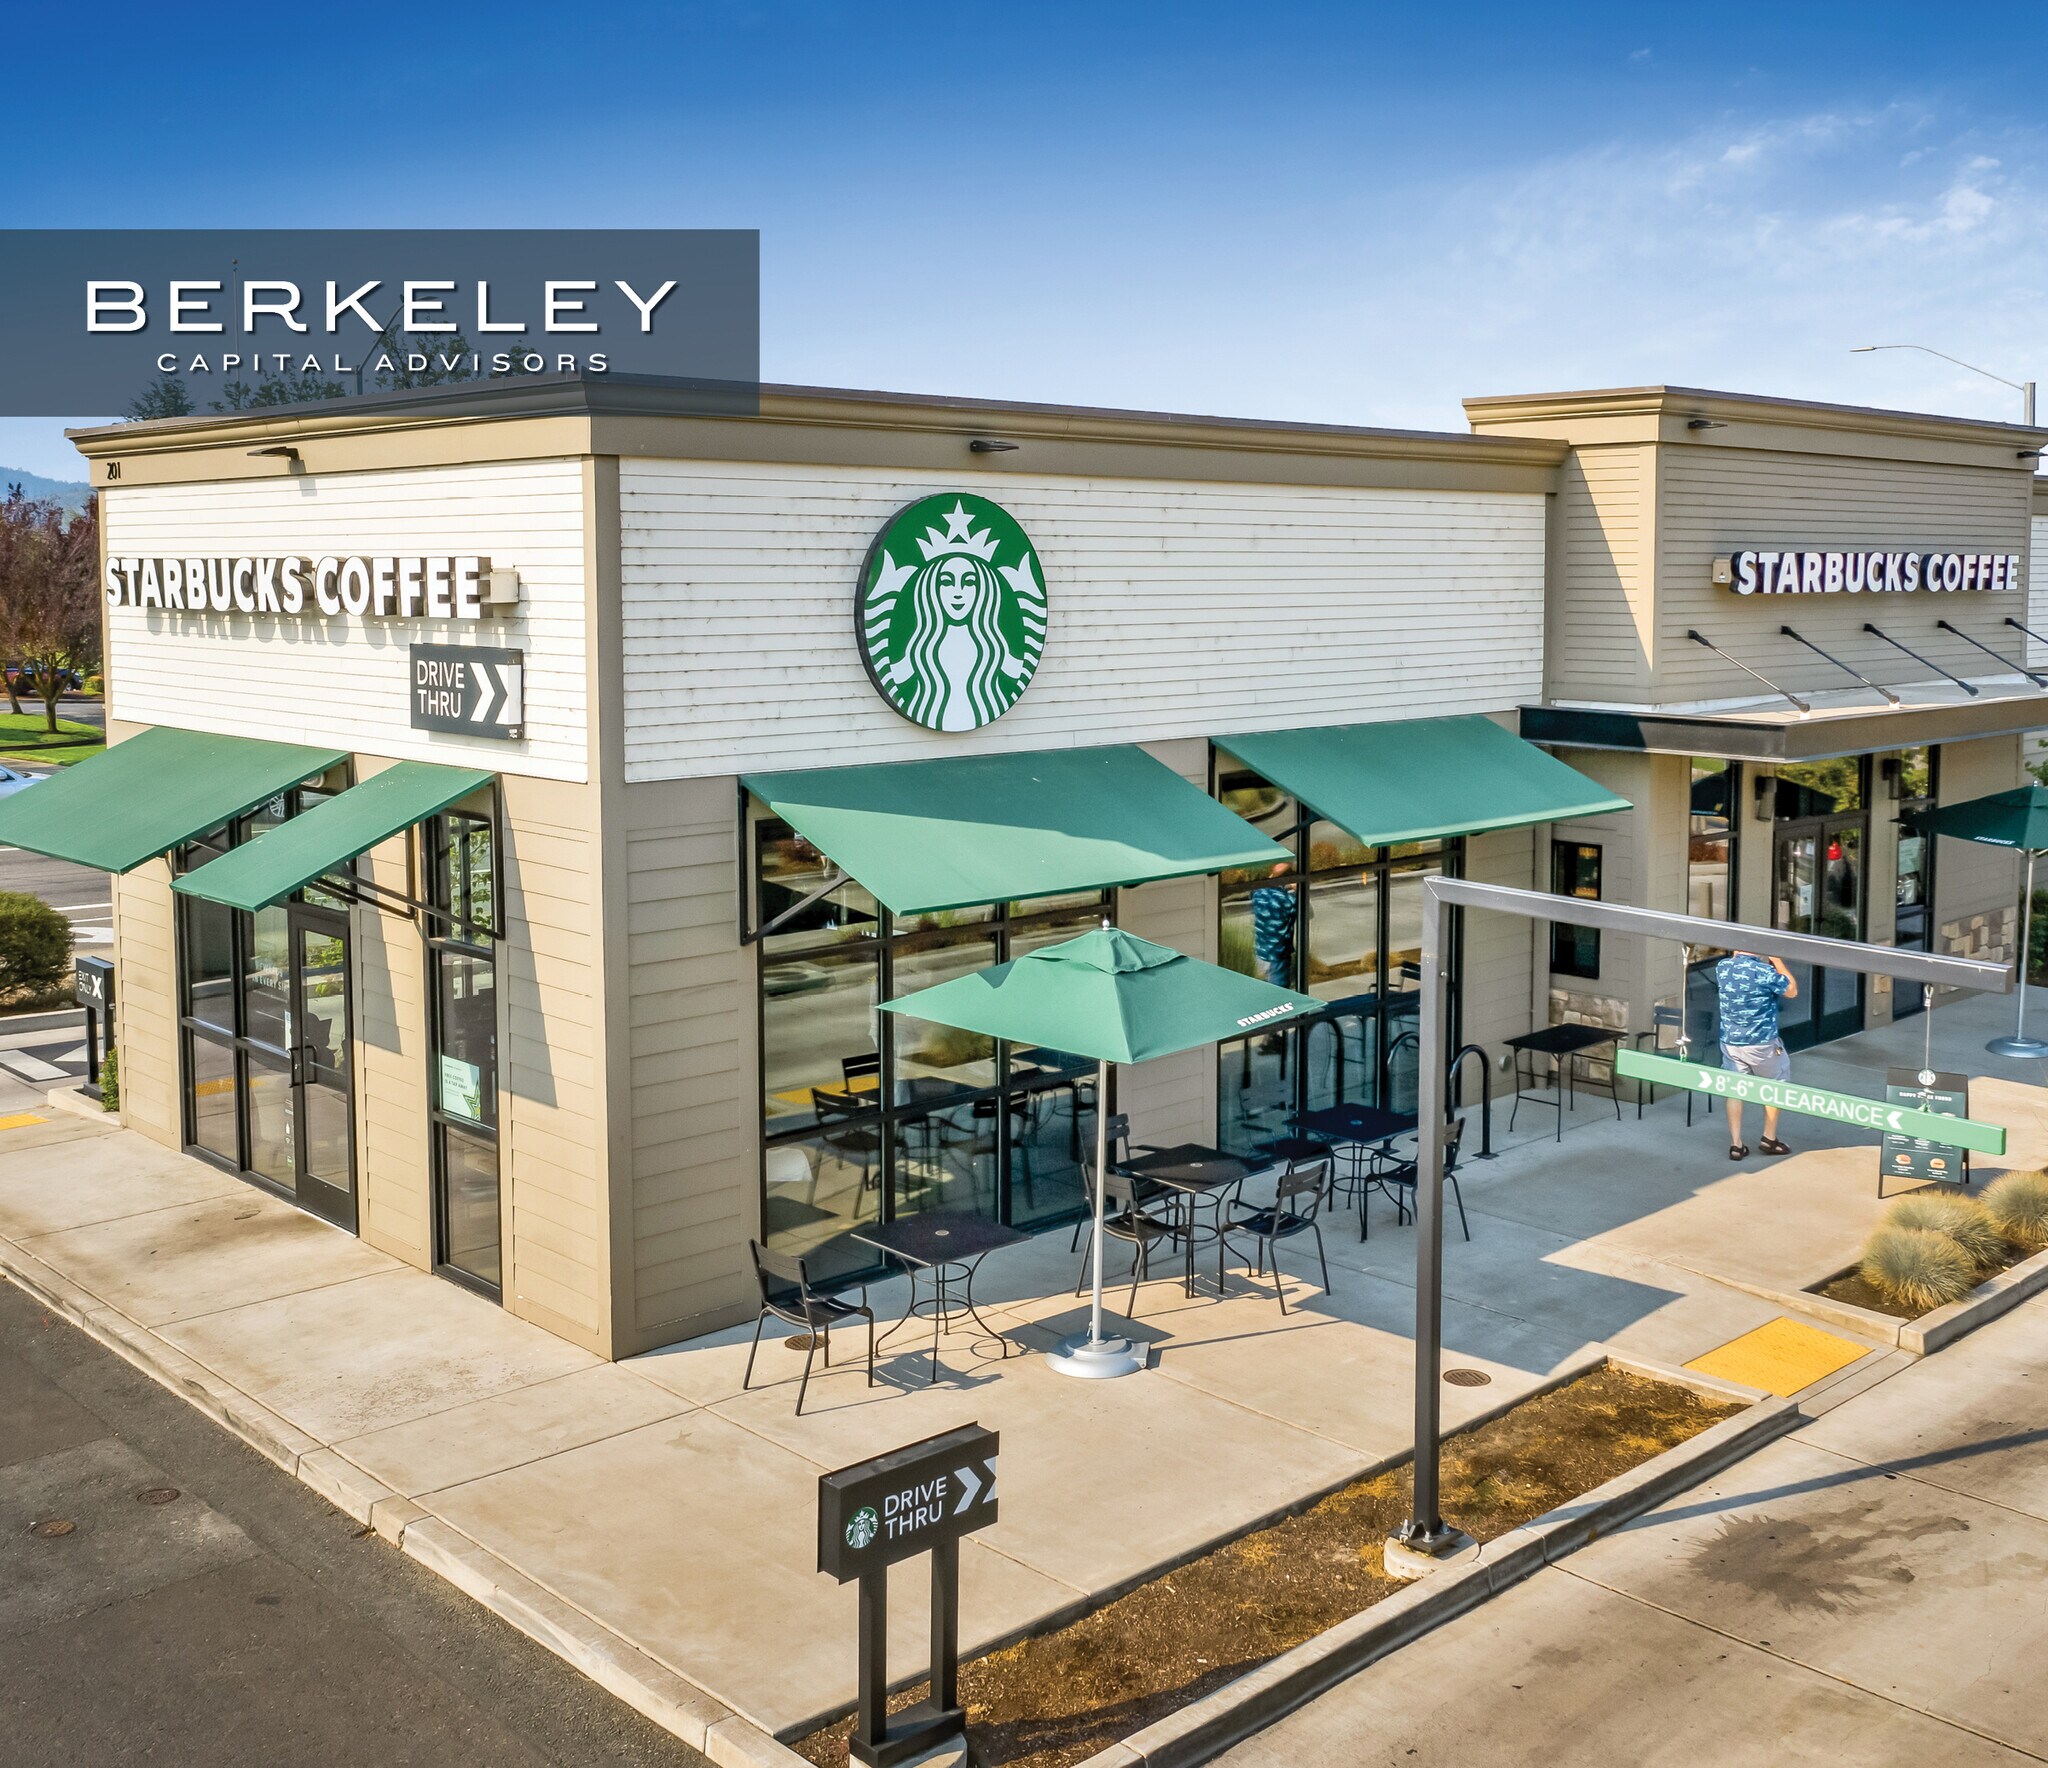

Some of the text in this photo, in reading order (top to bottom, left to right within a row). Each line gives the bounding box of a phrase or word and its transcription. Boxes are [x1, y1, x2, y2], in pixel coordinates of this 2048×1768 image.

[106, 461, 121, 480] 201
[106, 556, 482, 620] STARBUCKS COFFEE
[1736, 551, 2020, 595] STARBUCKS COFFEE
[416, 659, 465, 689] DRIVE
[417, 689, 461, 718] THRU
[1236, 1002, 1295, 1027] STARBUCKS
[1759, 1084, 1884, 1126] CLEARANCE
[884, 1476, 947, 1518] DRIVE
[884, 1500, 943, 1540] THRU
